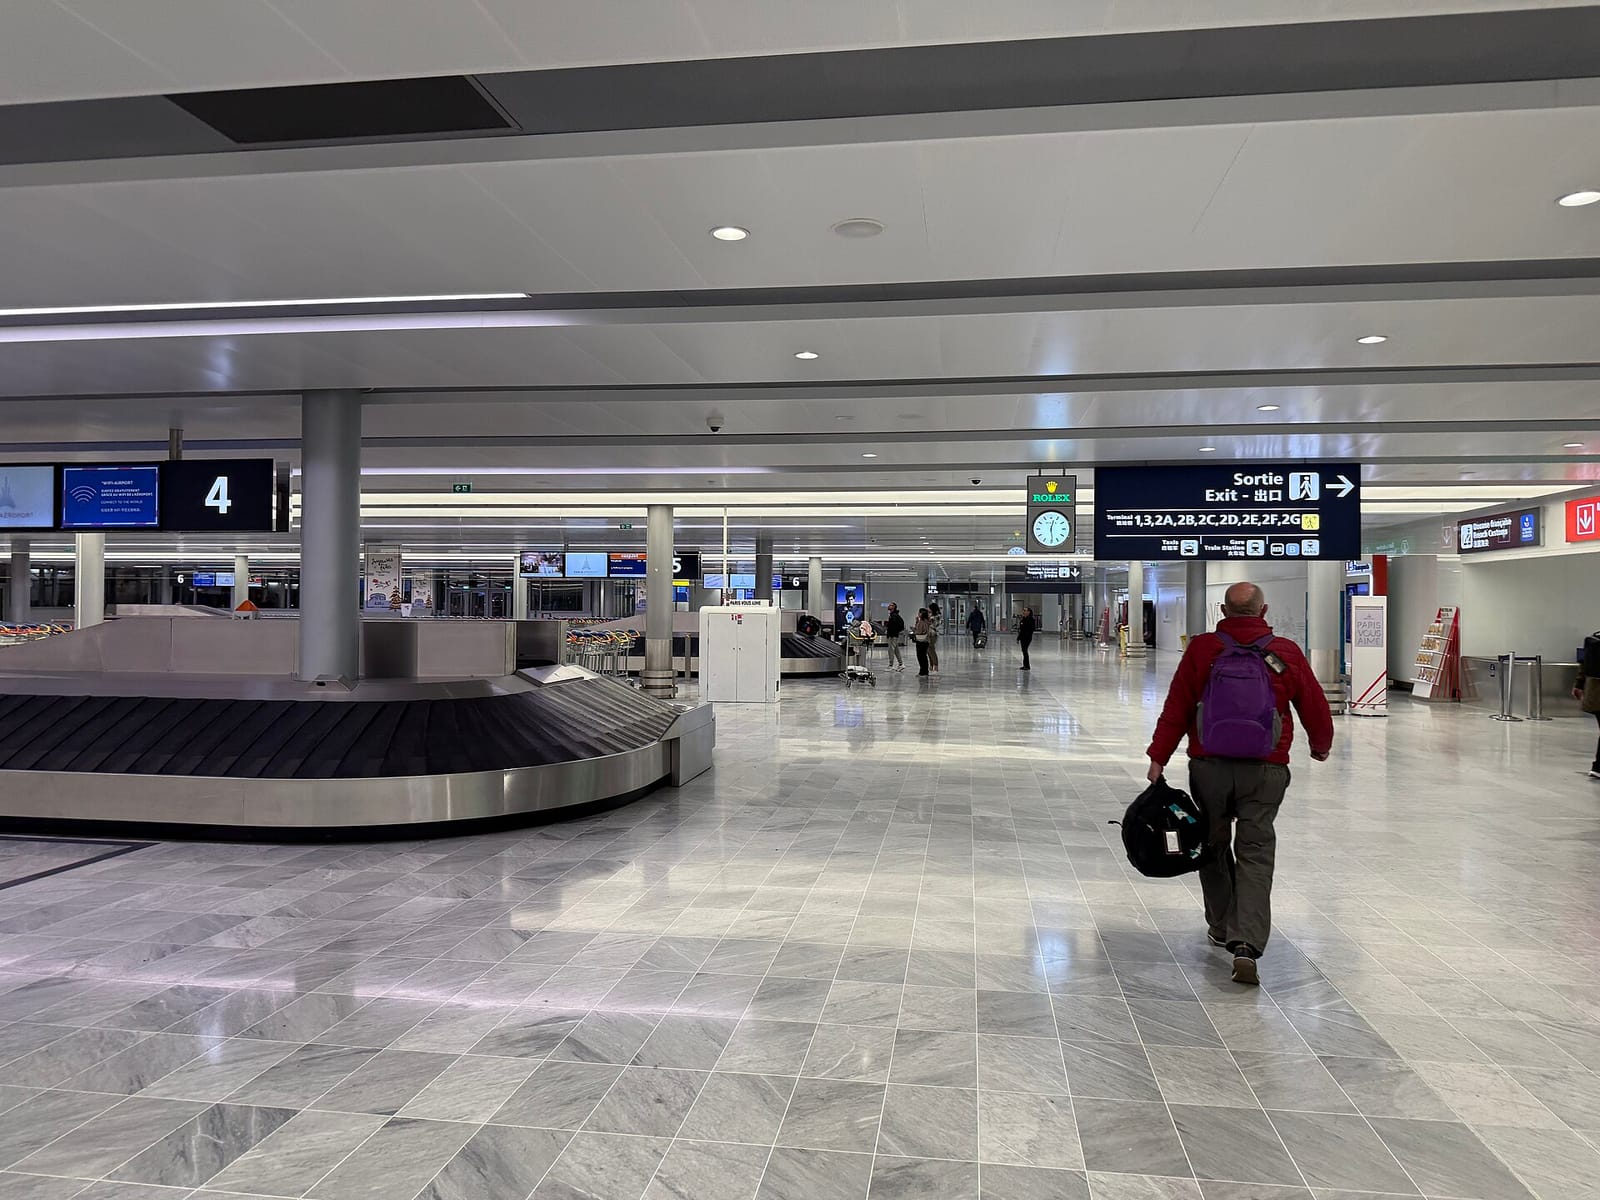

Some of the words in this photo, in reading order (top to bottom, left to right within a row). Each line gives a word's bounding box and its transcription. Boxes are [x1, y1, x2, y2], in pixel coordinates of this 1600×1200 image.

[1233, 473, 1283, 486] Sortie
[205, 476, 231, 514] 4
[1033, 494, 1071, 502] ROLEX
[1205, 489, 1238, 502] Exit
[1254, 489, 1282, 502] 出口
[672, 558, 681, 573] 5
[178, 574, 184, 584] 6
[792, 577, 799, 587] 6
[1357, 621, 1382, 629] PARIS
[1358, 629, 1382, 637] VOUS
[1357, 637, 1381, 645] AIME
